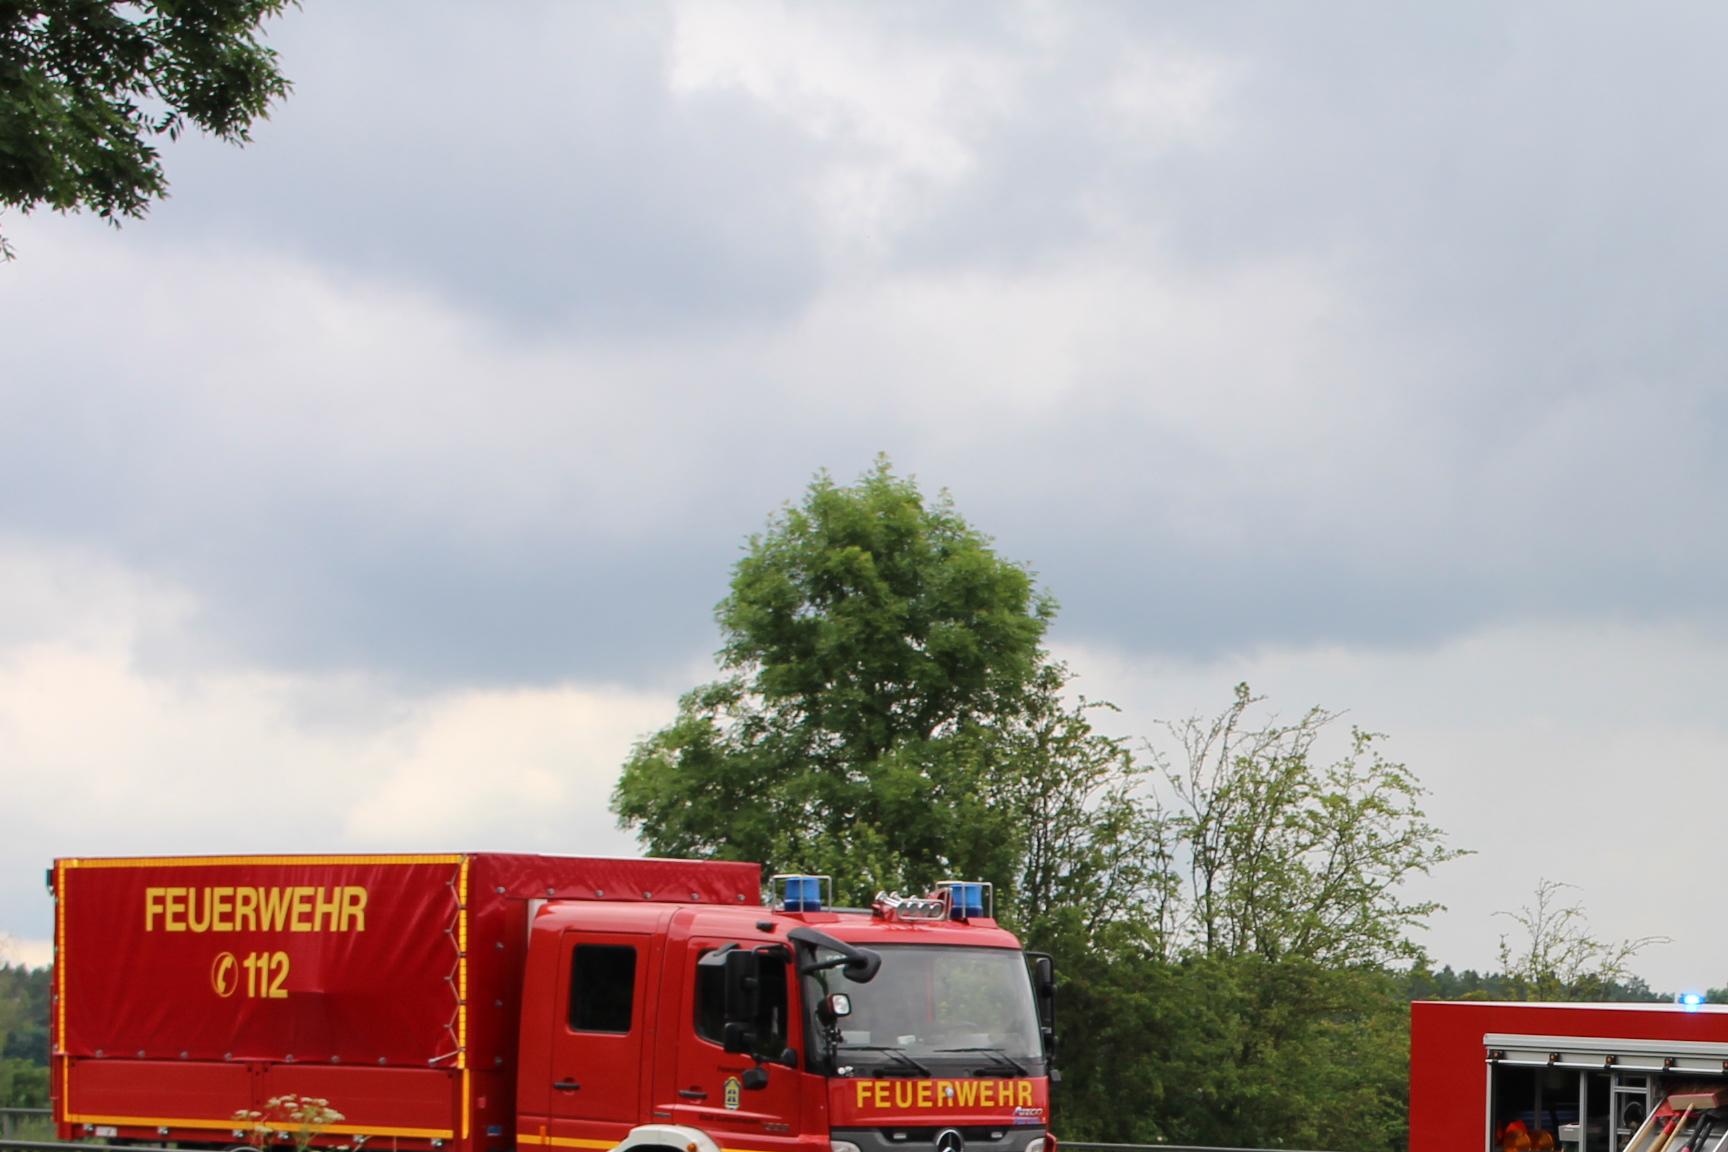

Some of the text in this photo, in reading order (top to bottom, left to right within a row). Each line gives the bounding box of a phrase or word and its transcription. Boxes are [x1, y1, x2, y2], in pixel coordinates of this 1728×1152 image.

[145, 886, 368, 933] FEUERWEHR
[242, 951, 290, 998] 112
[856, 1080, 1033, 1108] FEUERWEHR
